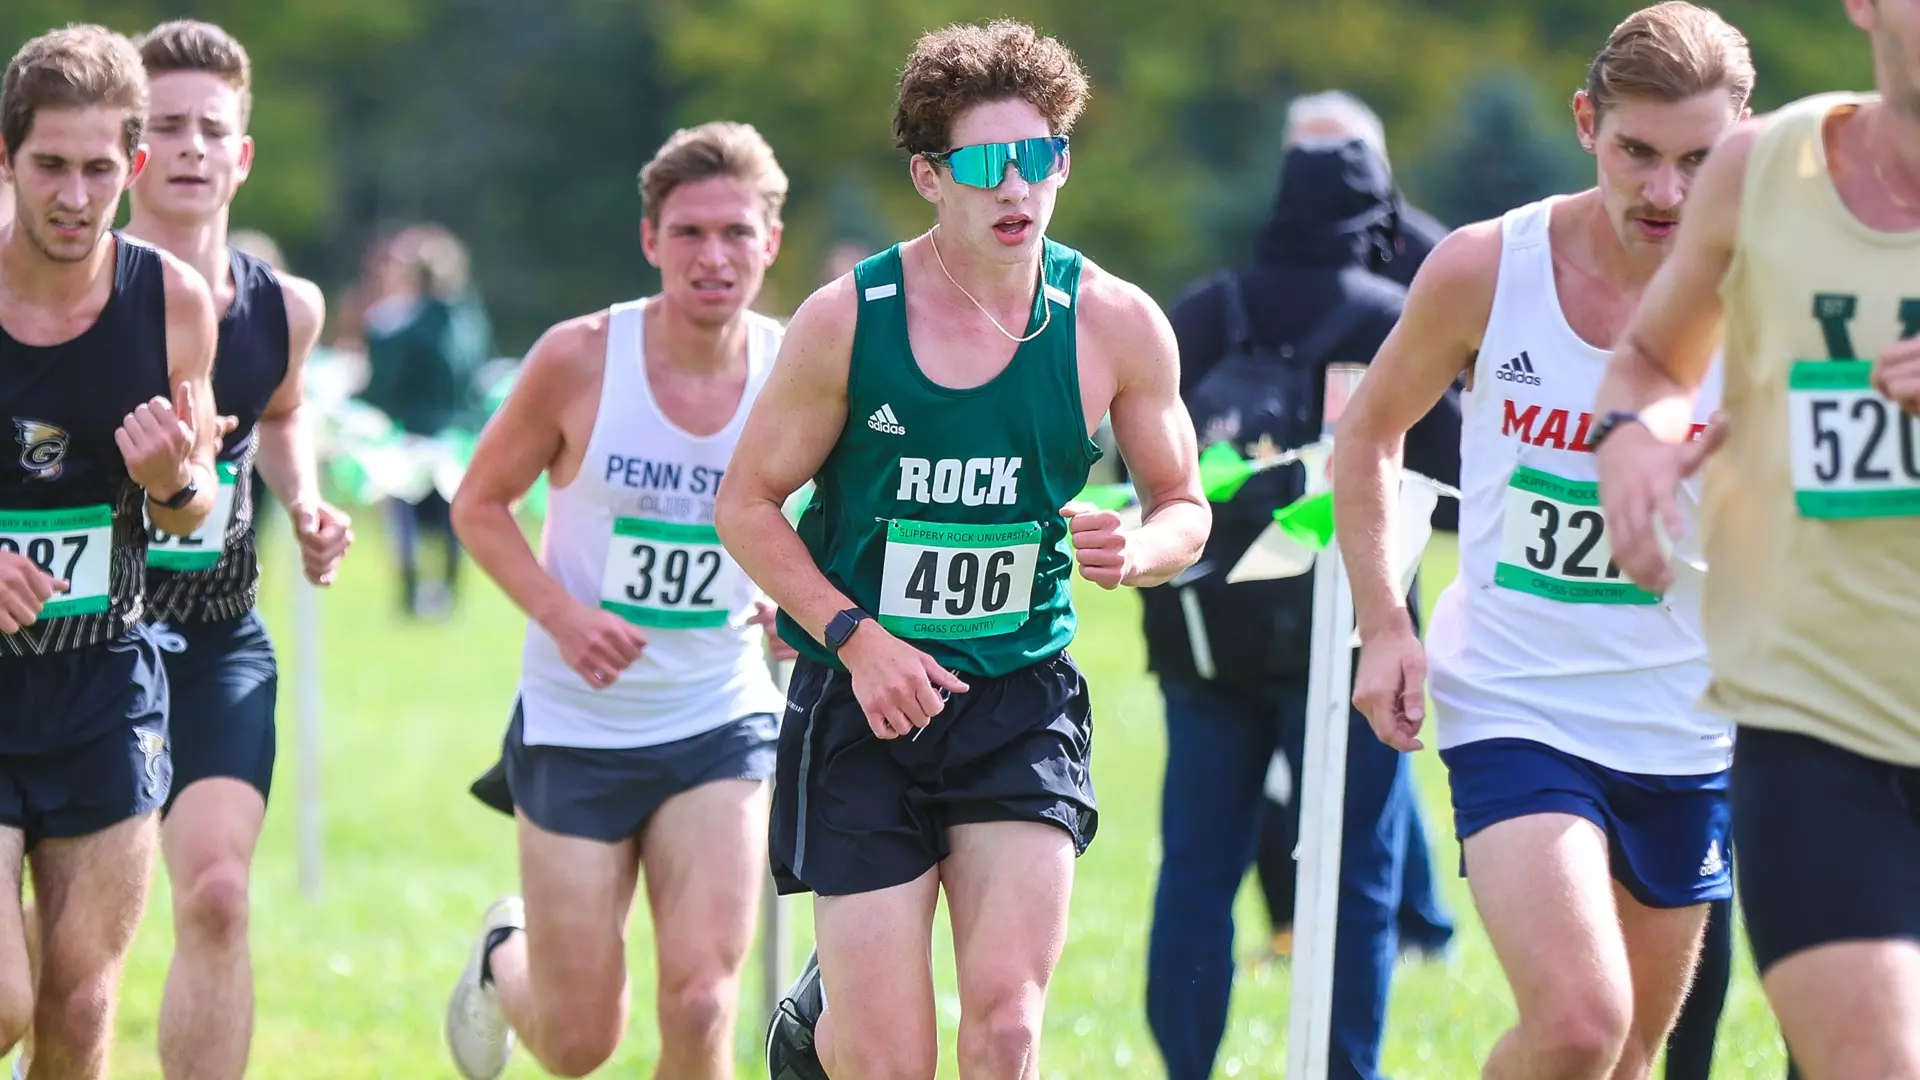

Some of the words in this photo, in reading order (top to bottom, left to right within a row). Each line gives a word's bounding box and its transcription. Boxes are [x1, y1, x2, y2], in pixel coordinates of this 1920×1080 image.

[1496, 369, 1541, 387] adidas
[867, 419, 906, 436] adidas
[605, 455, 682, 490] PENN
[896, 457, 1022, 506] ROCK
[1519, 474, 1564, 495] SLIPPERY
[1567, 487, 1597, 500] ROCK
[637, 495, 690, 518] CLUB
[899, 527, 945, 541] SLIPPERY
[947, 533, 975, 542] ROCK
[977, 530, 1032, 543] UNIVERSITY
[0, 535, 88, 595] 87
[625, 544, 721, 607] 392
[904, 550, 1015, 616] 496
[1531, 577, 1568, 597] CROSS
[1569, 586, 1627, 599] COUNTRY
[913, 623, 947, 633] CROSS
[950, 620, 996, 634] COUNTRY
